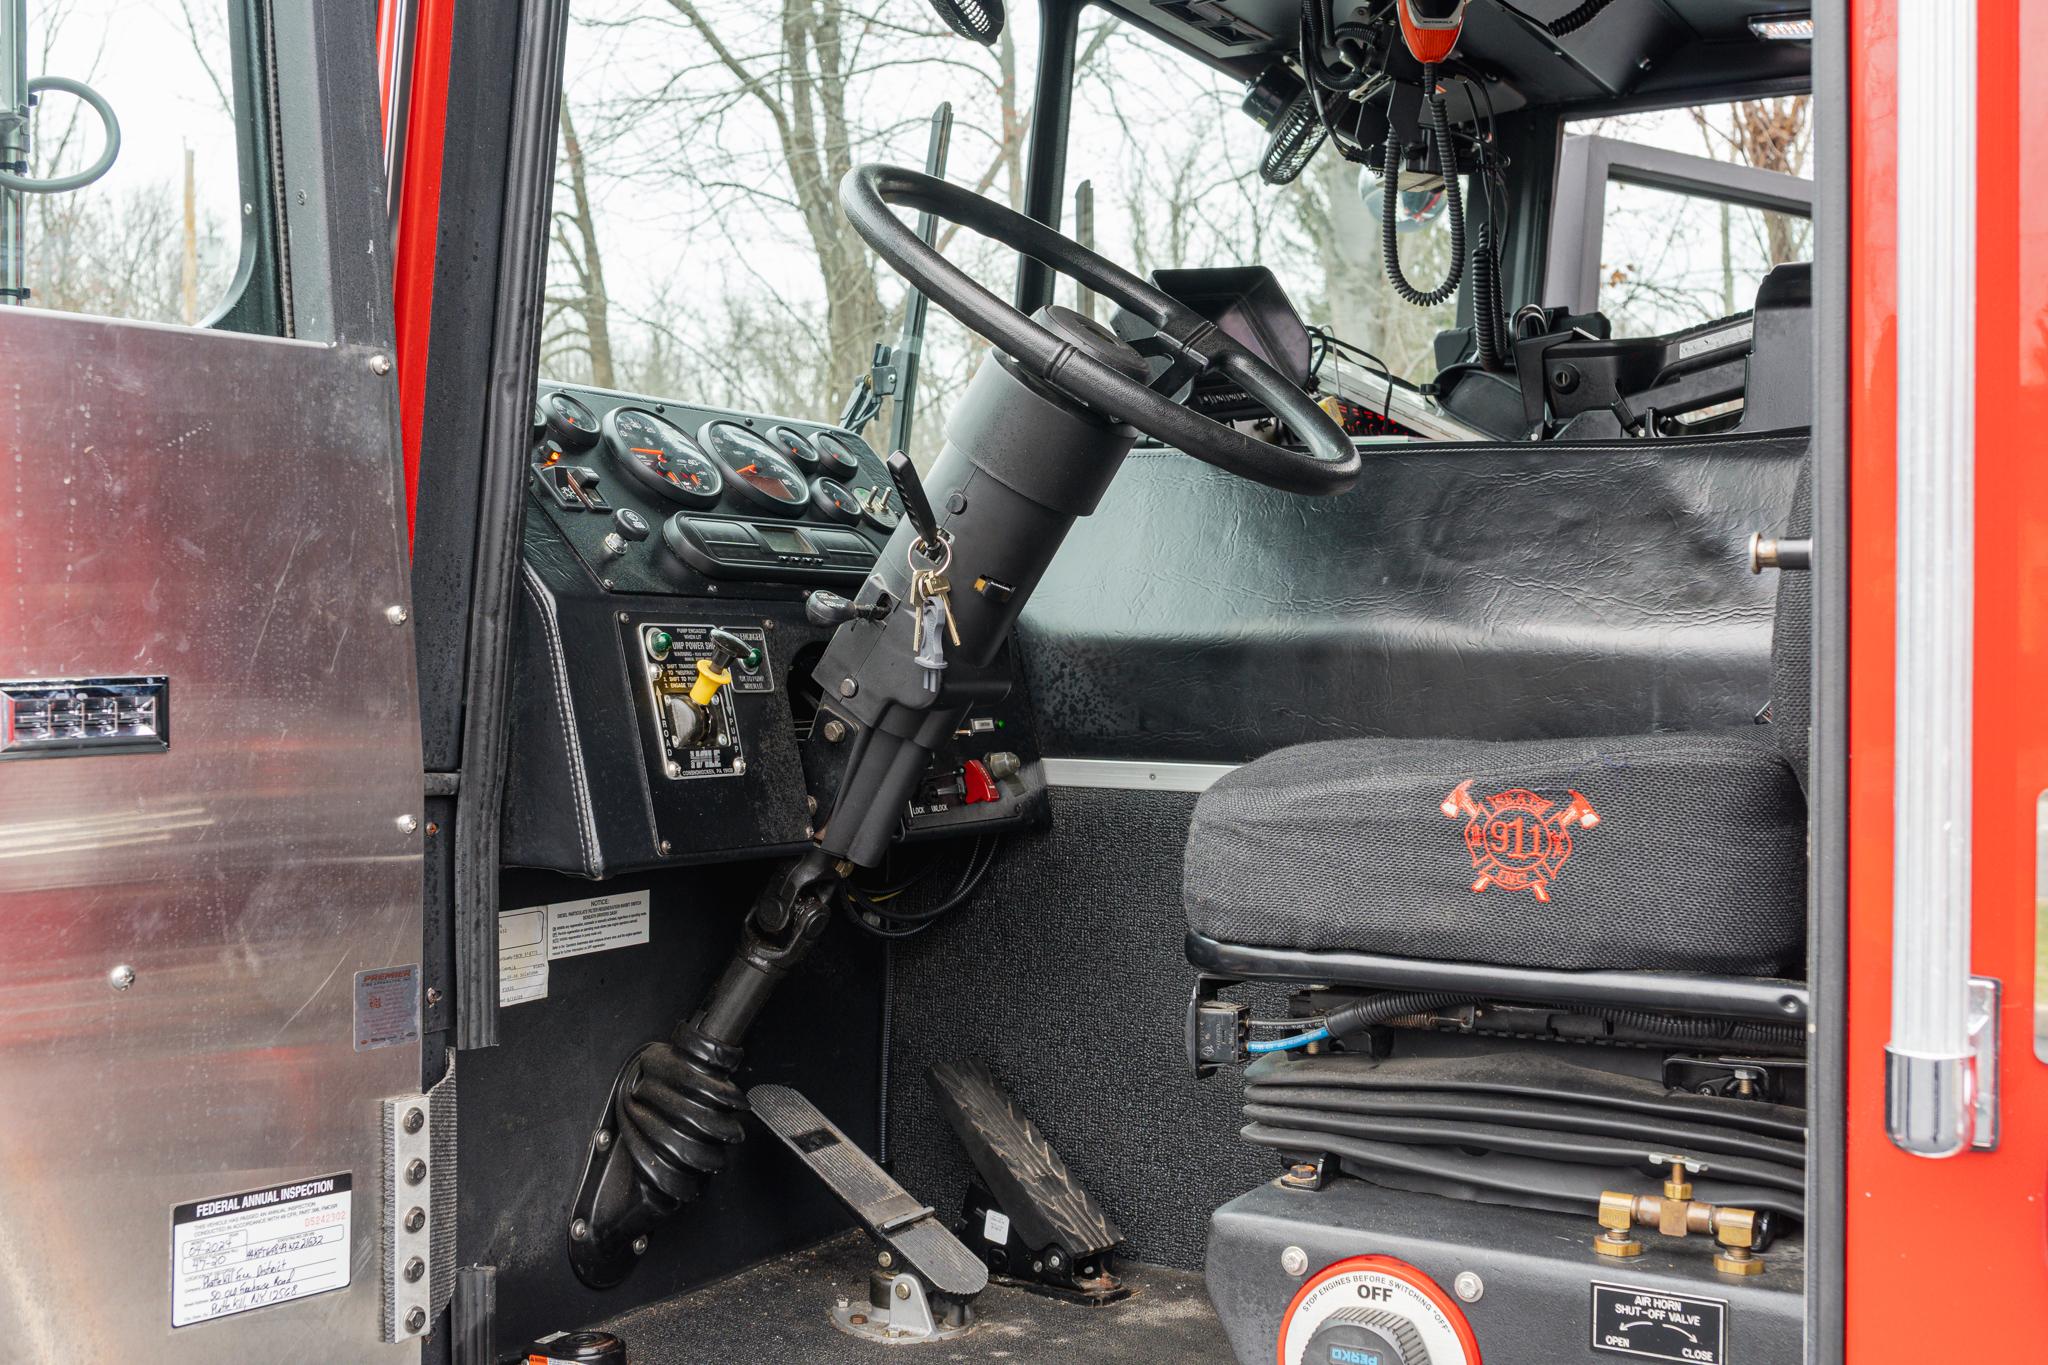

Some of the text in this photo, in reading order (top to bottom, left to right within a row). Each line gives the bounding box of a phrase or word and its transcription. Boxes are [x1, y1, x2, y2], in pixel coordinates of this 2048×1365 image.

[672, 641, 685, 650] UMP
[685, 641, 705, 650] POWER
[661, 720, 673, 757] ROAD
[729, 718, 739, 753] PUMP
[690, 749, 721, 769] HALE
[913, 804, 949, 815] LOCK UNLOCK
[1490, 817, 1544, 860] 911
[196, 1179, 334, 1217] FEDERAL ANNUAL INSPECTION
[1357, 1284, 1393, 1302] OFF
[1303, 1275, 1451, 1333] STOP ENGINES BEFORE SWITCHING "OFF"
[1633, 1295, 1682, 1312] AIR HORN
[1614, 1303, 1702, 1327] SHUT-OFF VALVE
[1605, 1334, 1630, 1348] OPEN
[1331, 1347, 1377, 1365] PERKO
[1681, 1347, 1714, 1362] CLOSE
